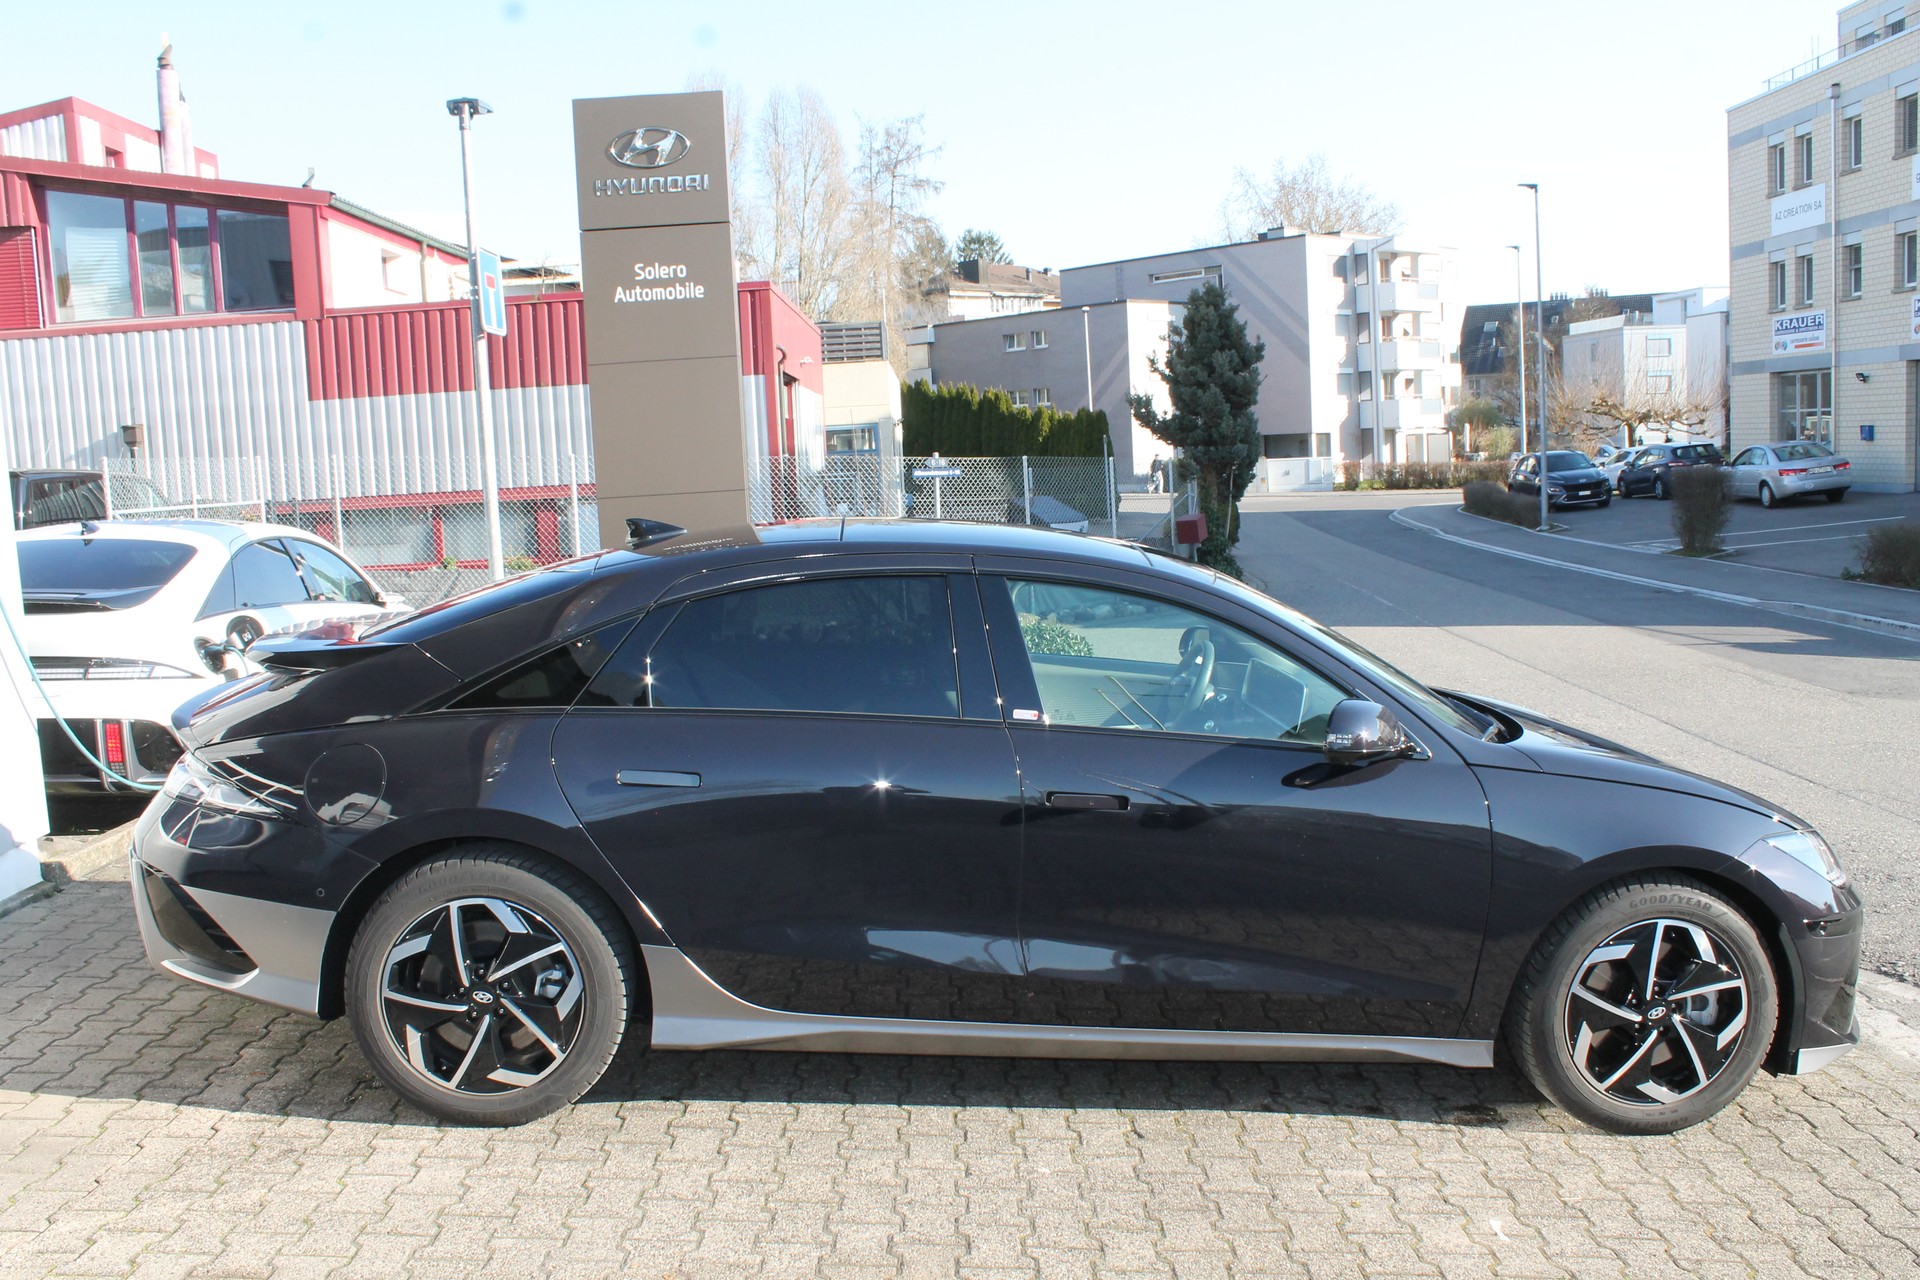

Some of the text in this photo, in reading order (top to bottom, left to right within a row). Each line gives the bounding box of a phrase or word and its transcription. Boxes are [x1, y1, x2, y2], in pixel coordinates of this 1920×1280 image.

[595, 174, 709, 196] HYUNDAI
[1774, 200, 1822, 221] AZ CREATION SA
[634, 262, 687, 281] Solero
[614, 283, 705, 303] Automobile
[1775, 314, 1824, 331] KRAUER
[1629, 894, 1712, 911] GOODYEAR
